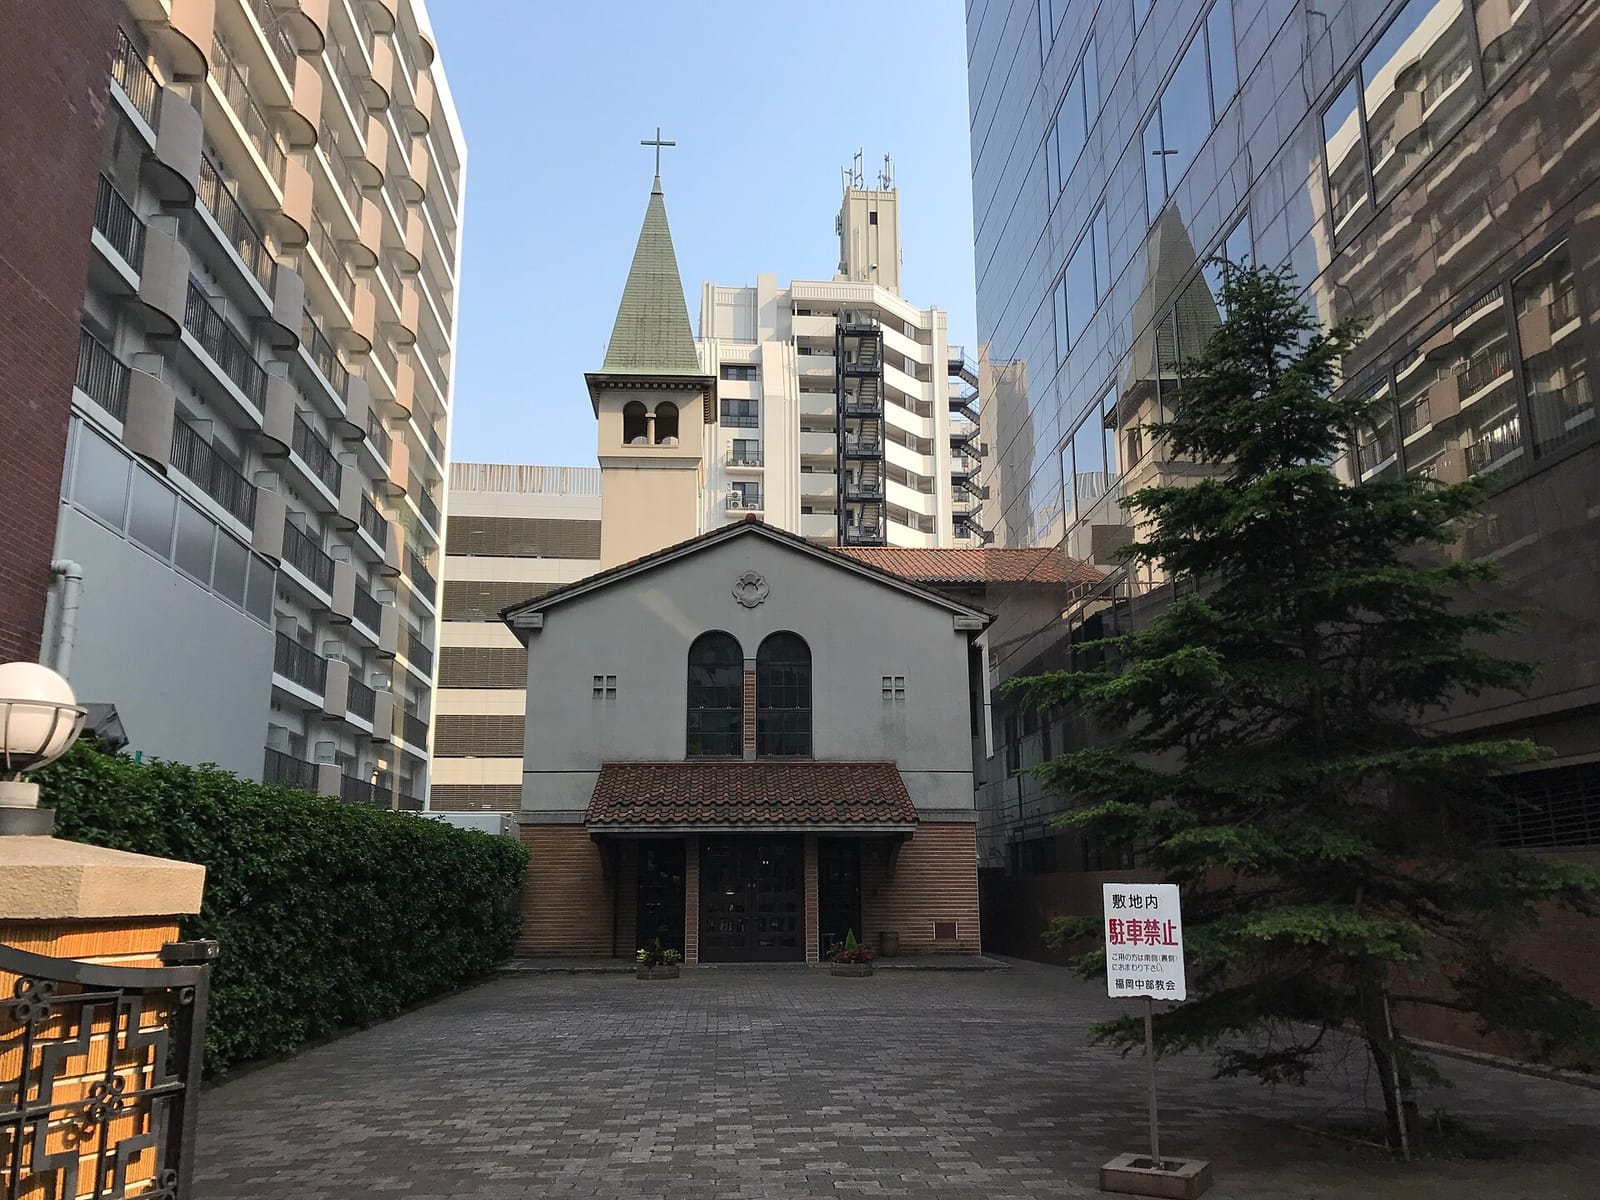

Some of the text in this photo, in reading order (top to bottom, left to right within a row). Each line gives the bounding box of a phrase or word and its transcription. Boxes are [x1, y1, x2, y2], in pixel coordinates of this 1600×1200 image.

[1112, 894, 1158, 909] 敷地内
[1108, 918, 1179, 946] 駐車禁止
[1115, 978, 1176, 991] 福岡中部教会
